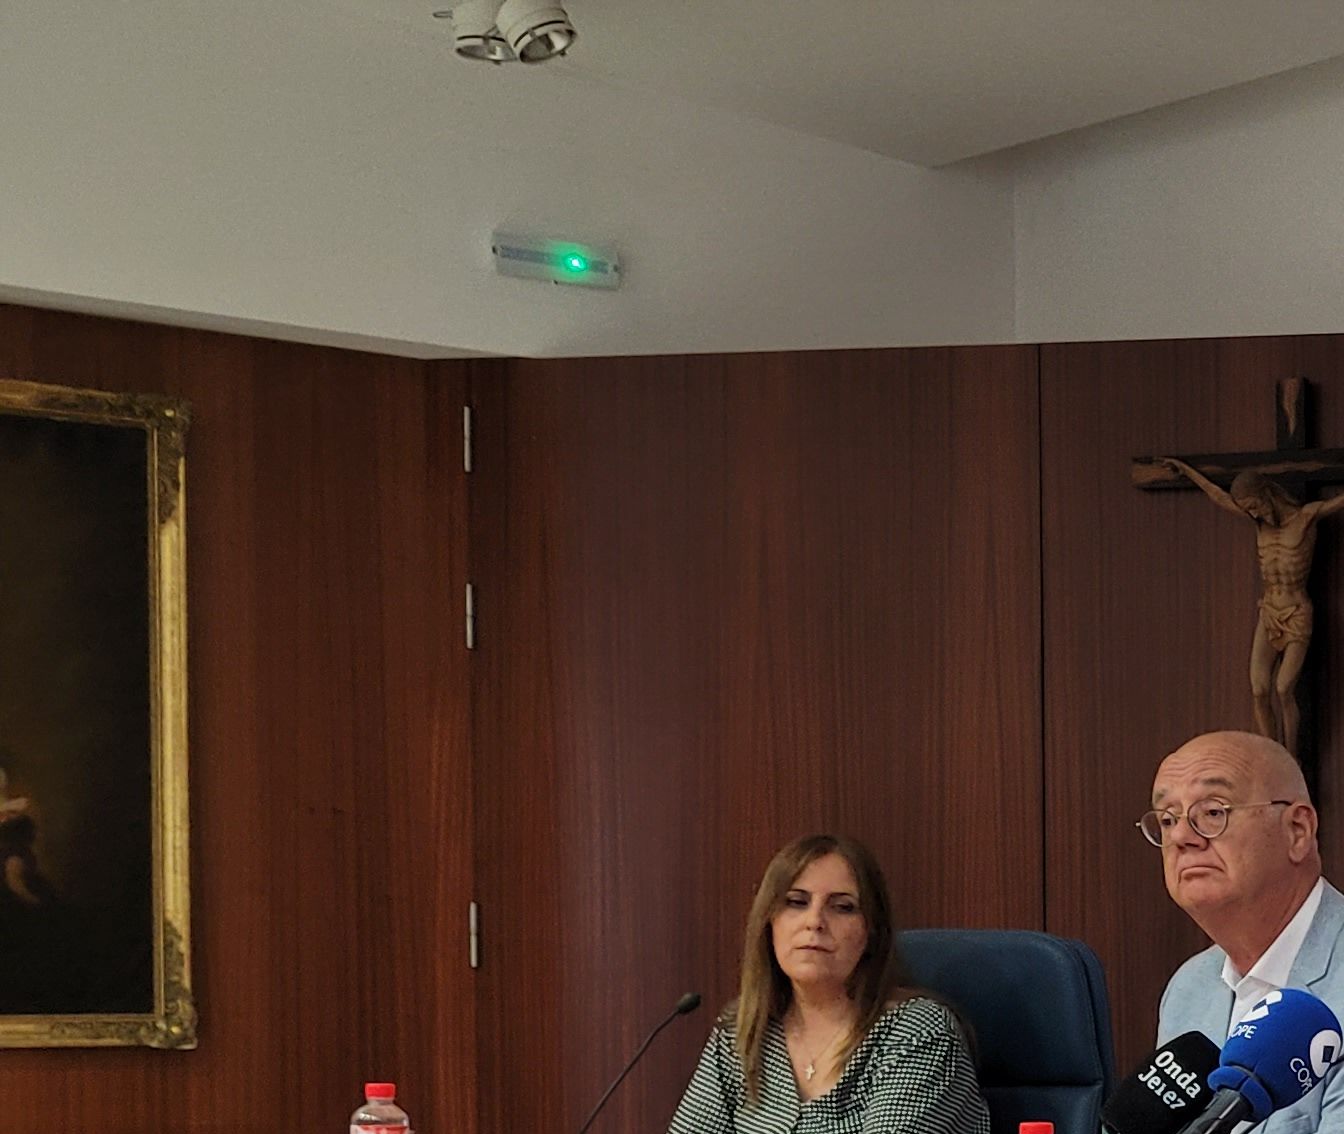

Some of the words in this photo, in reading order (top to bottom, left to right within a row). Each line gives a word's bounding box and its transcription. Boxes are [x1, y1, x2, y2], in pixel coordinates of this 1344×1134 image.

[1227, 1024, 1257, 1040] OPE
[1154, 1050, 1202, 1099] Onda
[1289, 1057, 1313, 1095] COP
